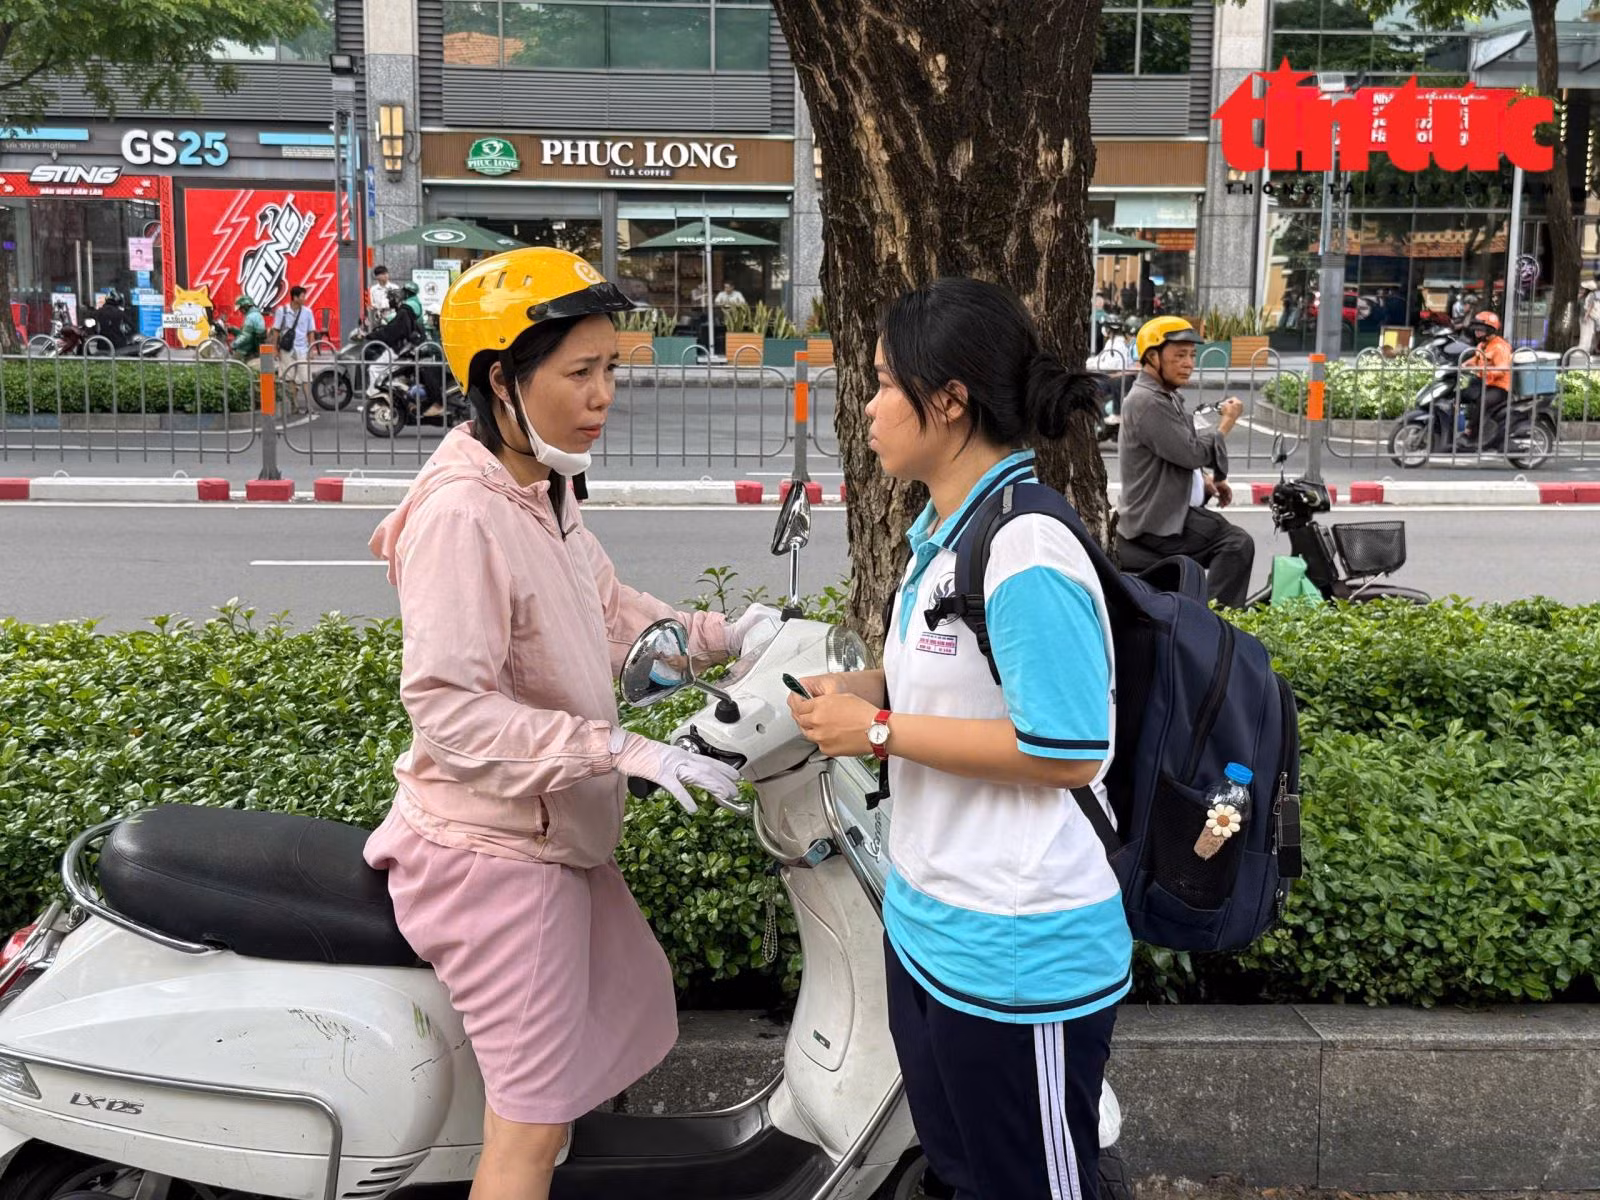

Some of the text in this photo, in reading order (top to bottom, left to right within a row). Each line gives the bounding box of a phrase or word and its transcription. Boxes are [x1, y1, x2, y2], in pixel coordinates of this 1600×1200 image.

[121, 129, 229, 167] GS25
[540, 139, 738, 169] PHUC LONG
[29, 165, 121, 184] STING
[494, 159, 519, 169] LONG
[638, 169, 671, 177] COFFEE
[245, 203, 301, 307] STING
